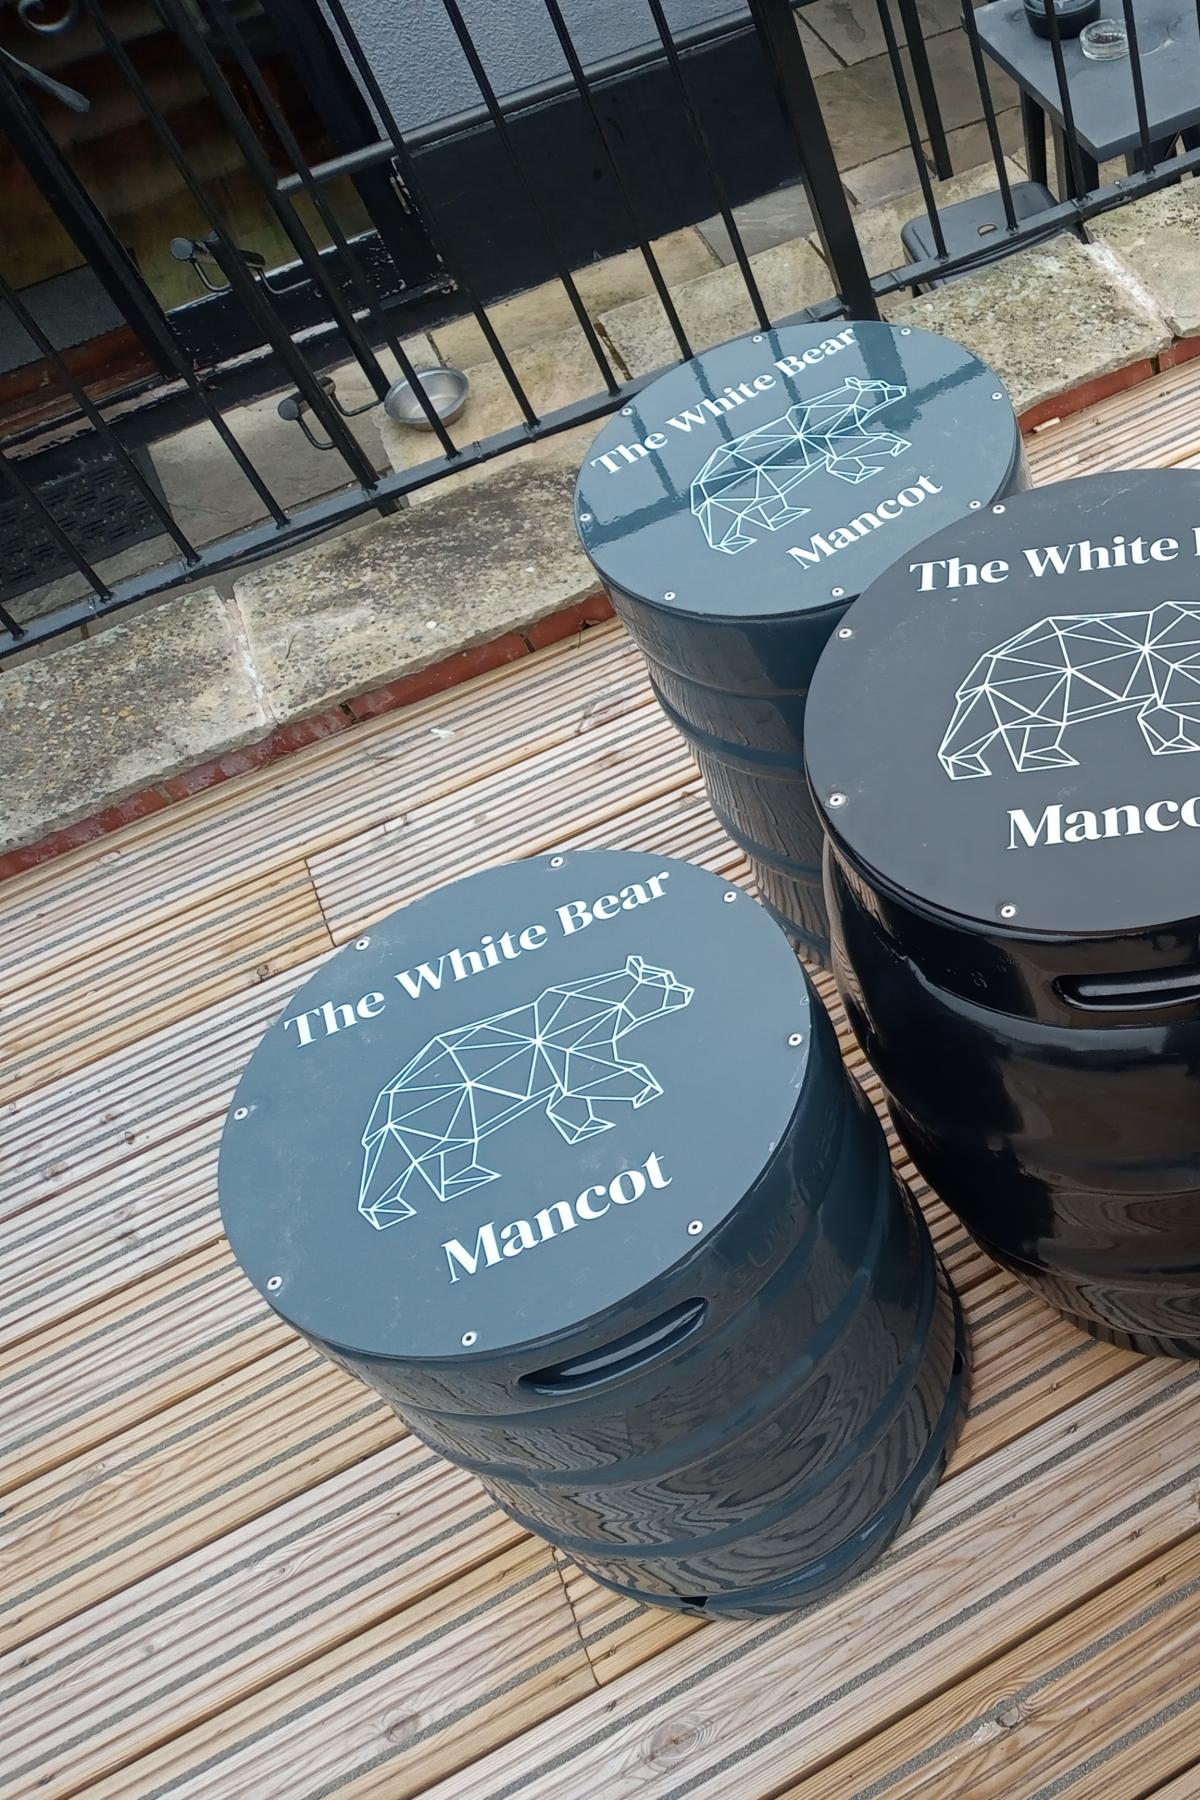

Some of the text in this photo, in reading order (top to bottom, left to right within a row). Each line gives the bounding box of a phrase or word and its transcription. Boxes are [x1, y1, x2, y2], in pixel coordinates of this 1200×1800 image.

[590, 327, 857, 475] The White Bear
[786, 473, 943, 570] Mancot
[908, 555, 1010, 592] The
[1020, 535, 1181, 580] White
[284, 870, 671, 1048] The White Bear
[442, 1152, 673, 1284] Mancot
